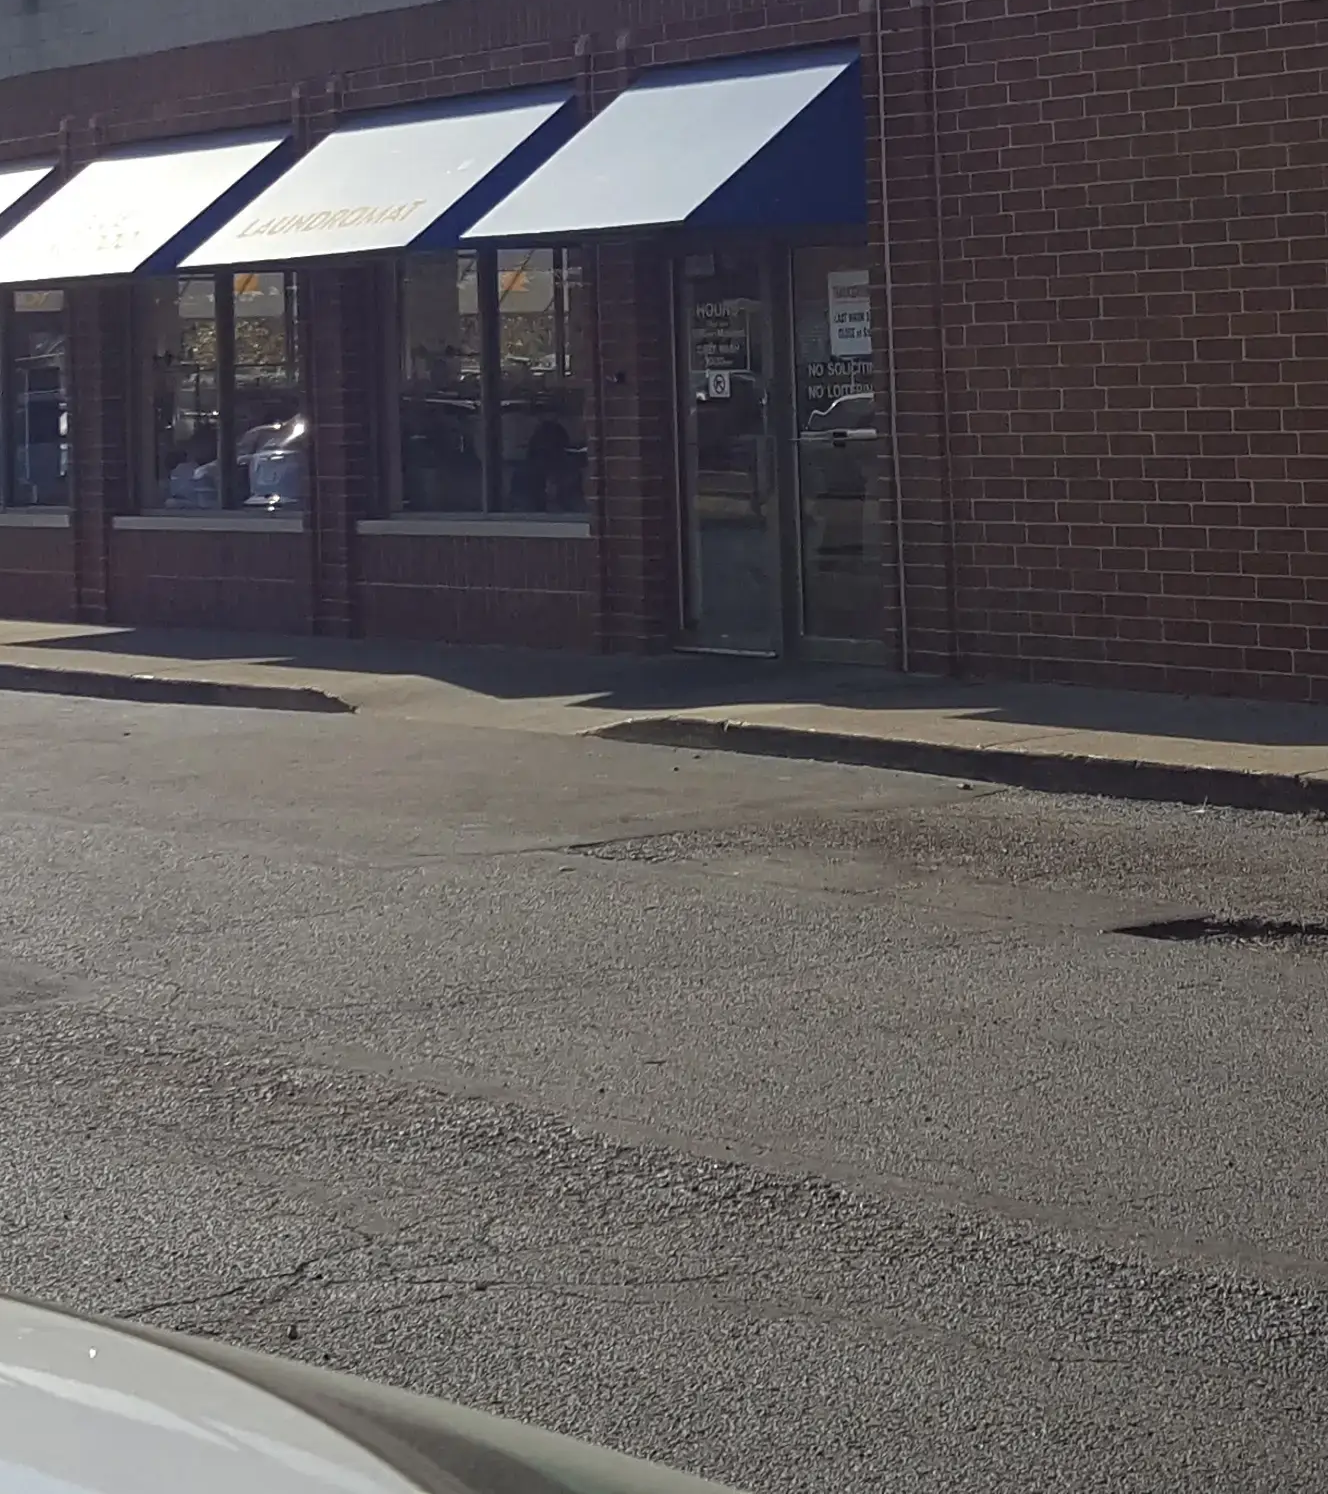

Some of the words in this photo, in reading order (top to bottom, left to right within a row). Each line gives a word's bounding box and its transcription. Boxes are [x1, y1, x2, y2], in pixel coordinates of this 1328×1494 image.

[236, 198, 427, 238] LAUNDROMAT
[808, 363, 824, 377] NO
[827, 361, 872, 376] SOLICITI
[808, 385, 824, 400] NO
